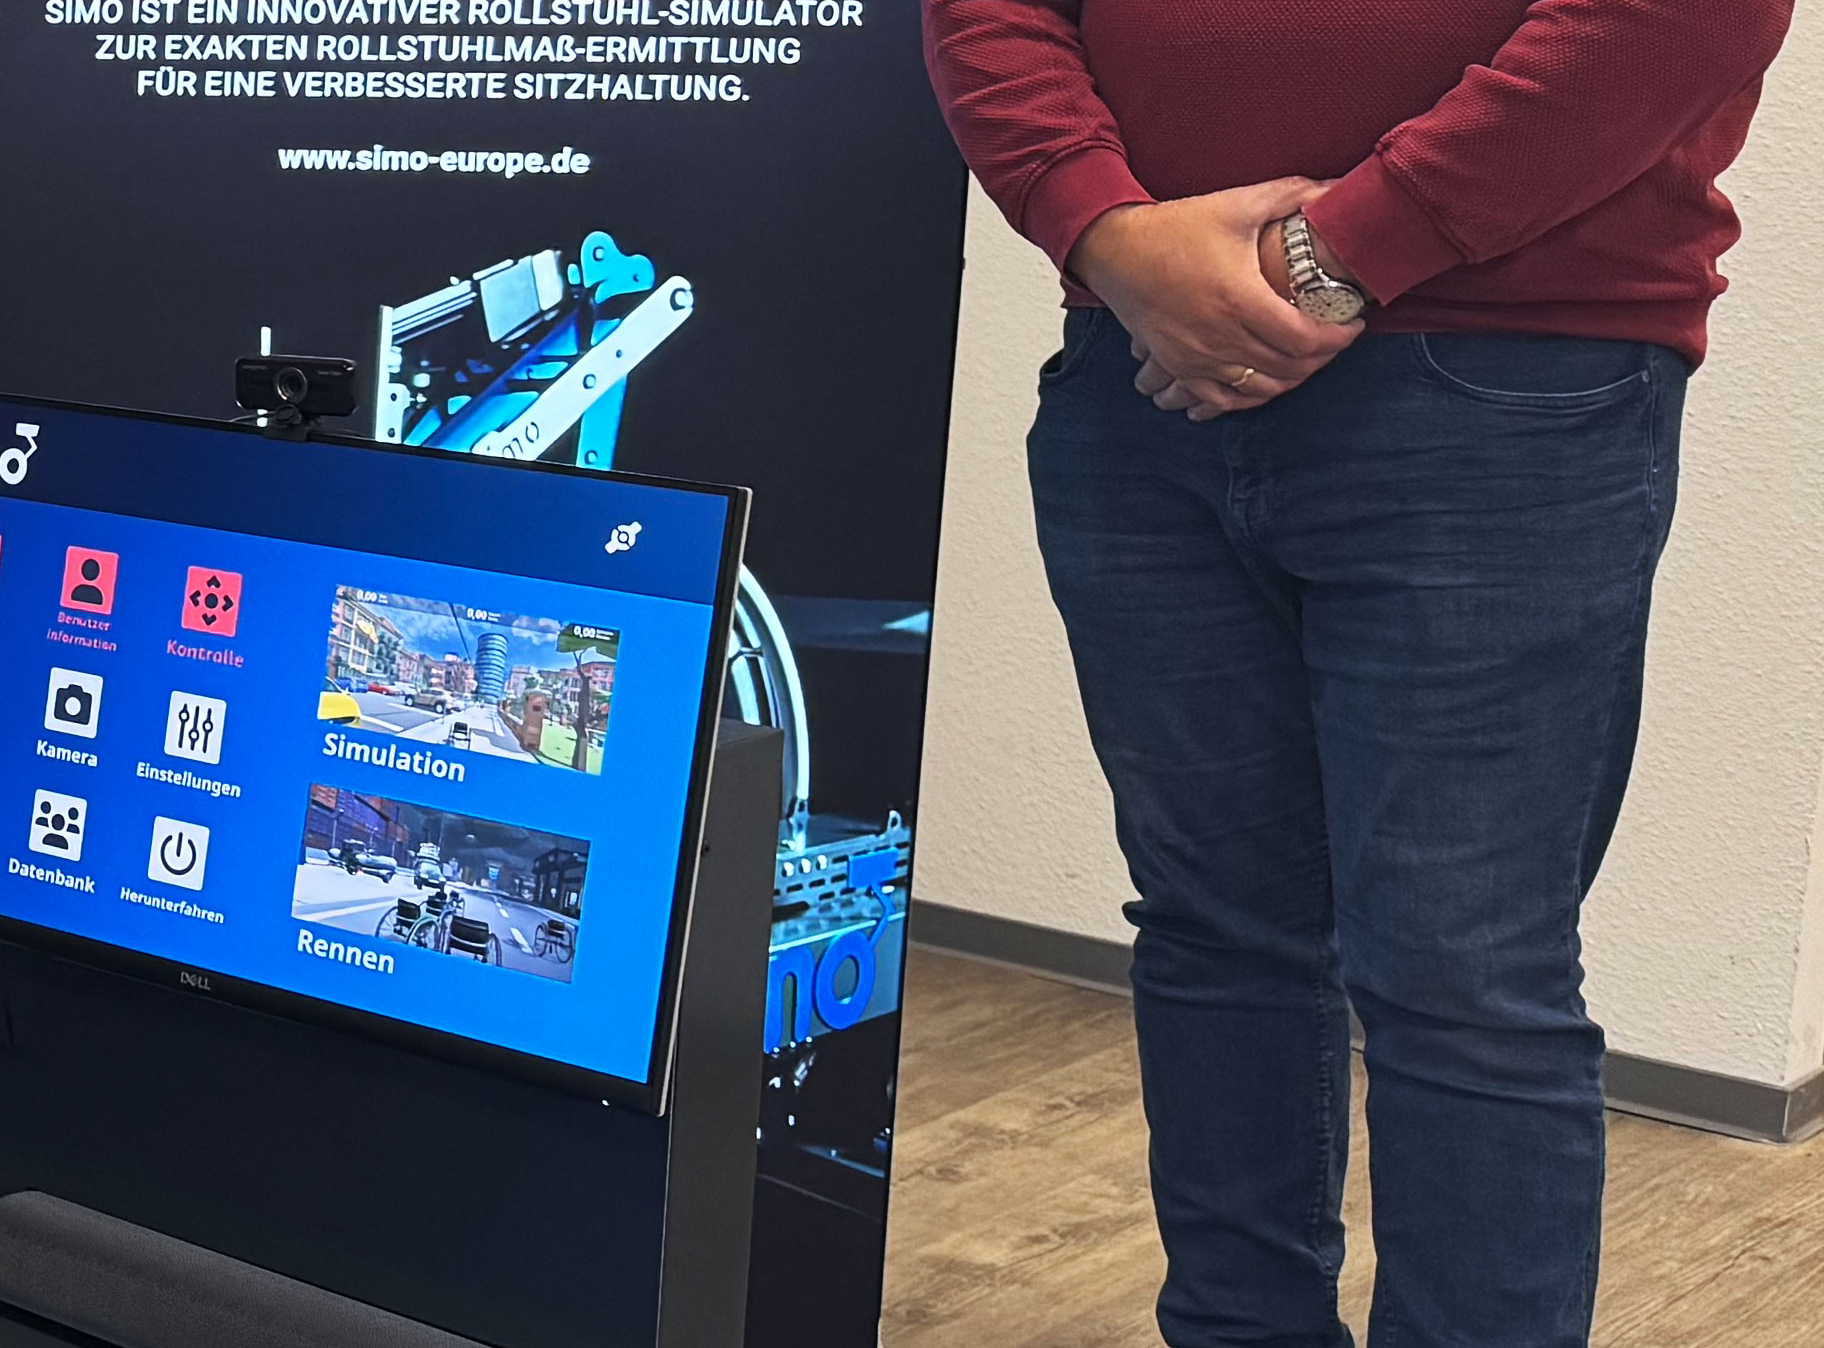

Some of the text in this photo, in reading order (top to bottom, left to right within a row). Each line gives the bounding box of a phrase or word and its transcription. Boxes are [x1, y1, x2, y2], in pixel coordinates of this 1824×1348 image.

[94, 34, 160, 60] ZUR
[165, 34, 309, 62] EXAKTEN
[137, 66, 750, 102] FÜR EINE VERBESSERTE SITZHALTUNG.
[277, 143, 592, 179] www.simo-europe.de
[57, 611, 112, 632] Benutzer
[166, 639, 245, 669] Kontrolle
[36, 740, 99, 768] Kamera
[322, 732, 467, 783] Simulation
[136, 762, 242, 799] Einstellungen
[8, 857, 96, 894] Datenbank
[120, 887, 224, 925] Herunterfahren
[297, 928, 395, 976] Rennen
